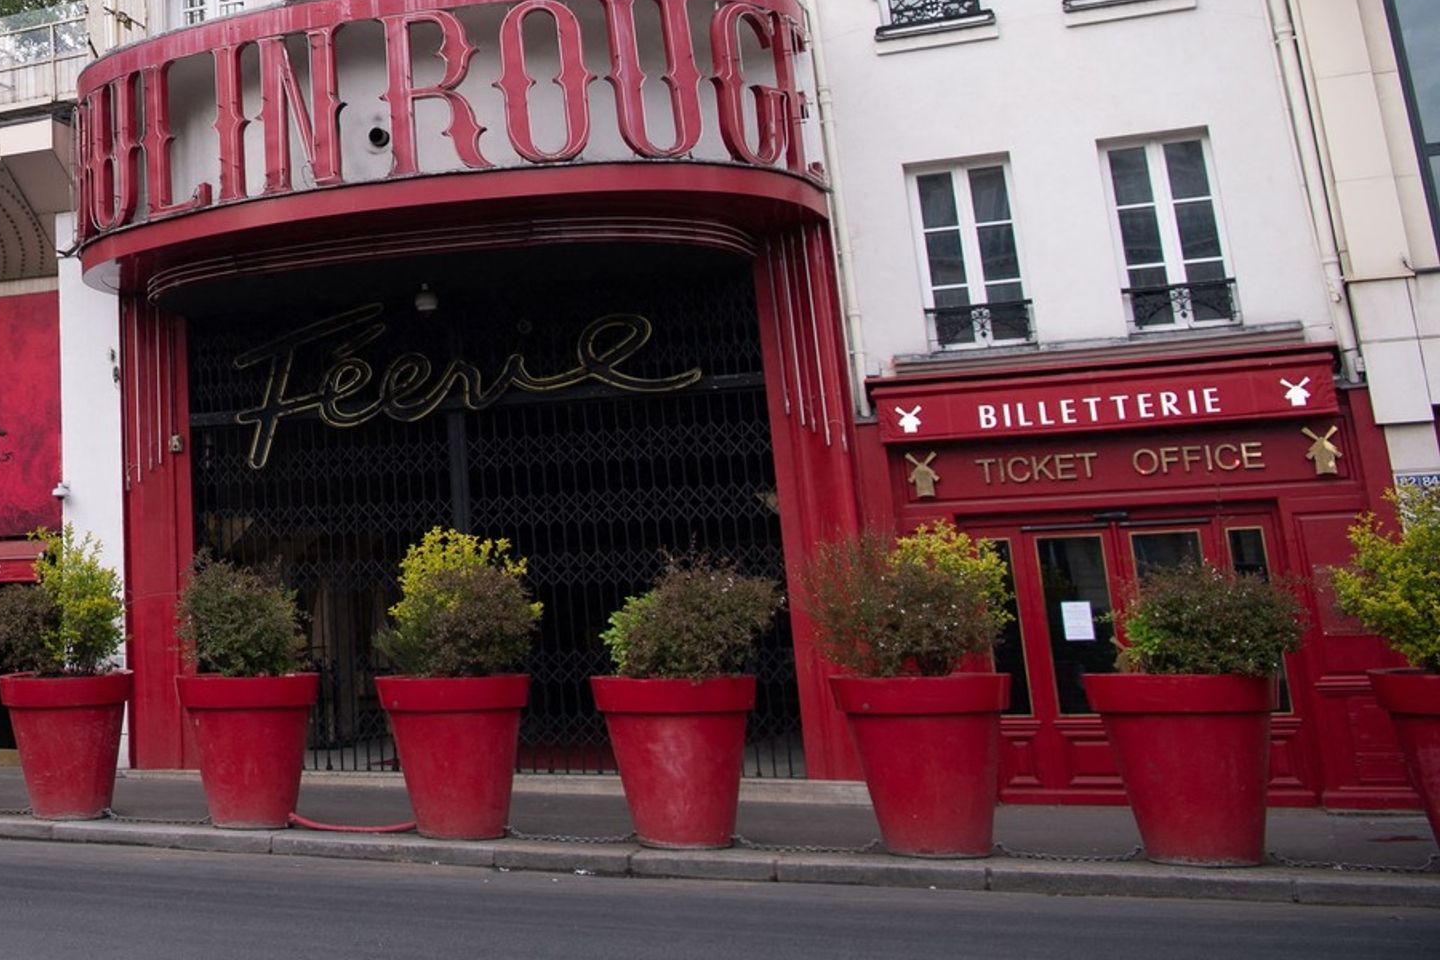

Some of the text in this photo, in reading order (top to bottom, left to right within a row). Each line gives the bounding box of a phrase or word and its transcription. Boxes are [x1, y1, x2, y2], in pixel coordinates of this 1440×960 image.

[978, 387, 1221, 429] BILLETTERIE
[975, 442, 1266, 484] TICKET OFFICE
